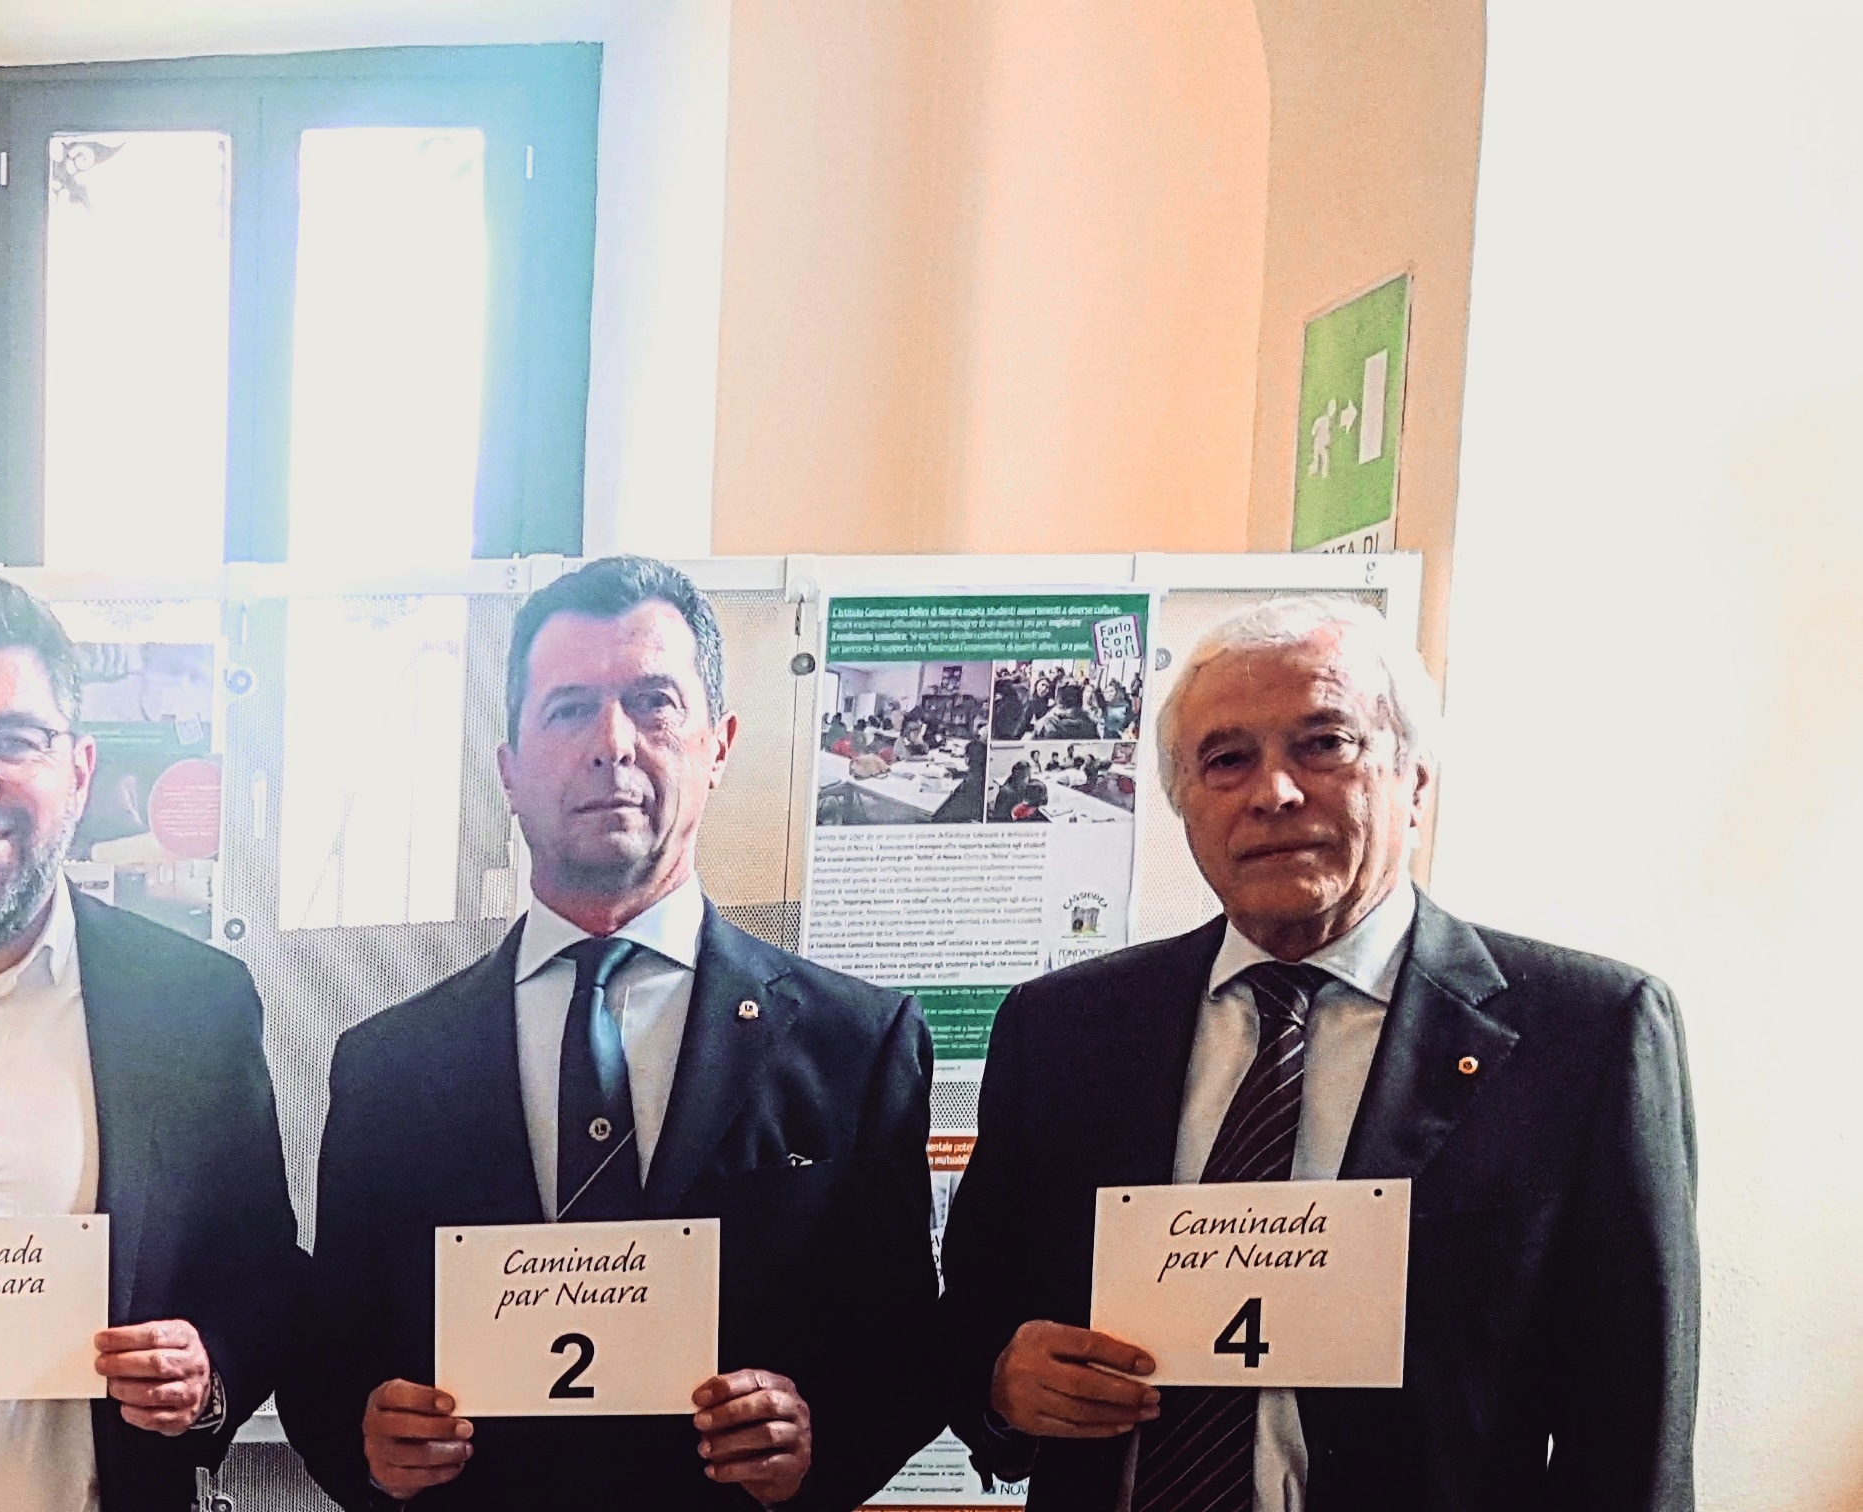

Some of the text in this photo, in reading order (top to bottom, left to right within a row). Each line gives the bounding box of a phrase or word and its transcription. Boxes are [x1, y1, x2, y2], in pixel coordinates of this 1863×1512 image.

[1100, 623, 1131, 637] Farlo
[1102, 634, 1133, 649] Con
[1169, 1201, 1328, 1236] Caminada
[503, 1240, 647, 1275] Caminada
[1156, 1243, 1329, 1283] par Nuara
[494, 1281, 649, 1319] par Nuara
[1213, 1297, 1270, 1368] 4
[548, 1332, 595, 1399] 2
